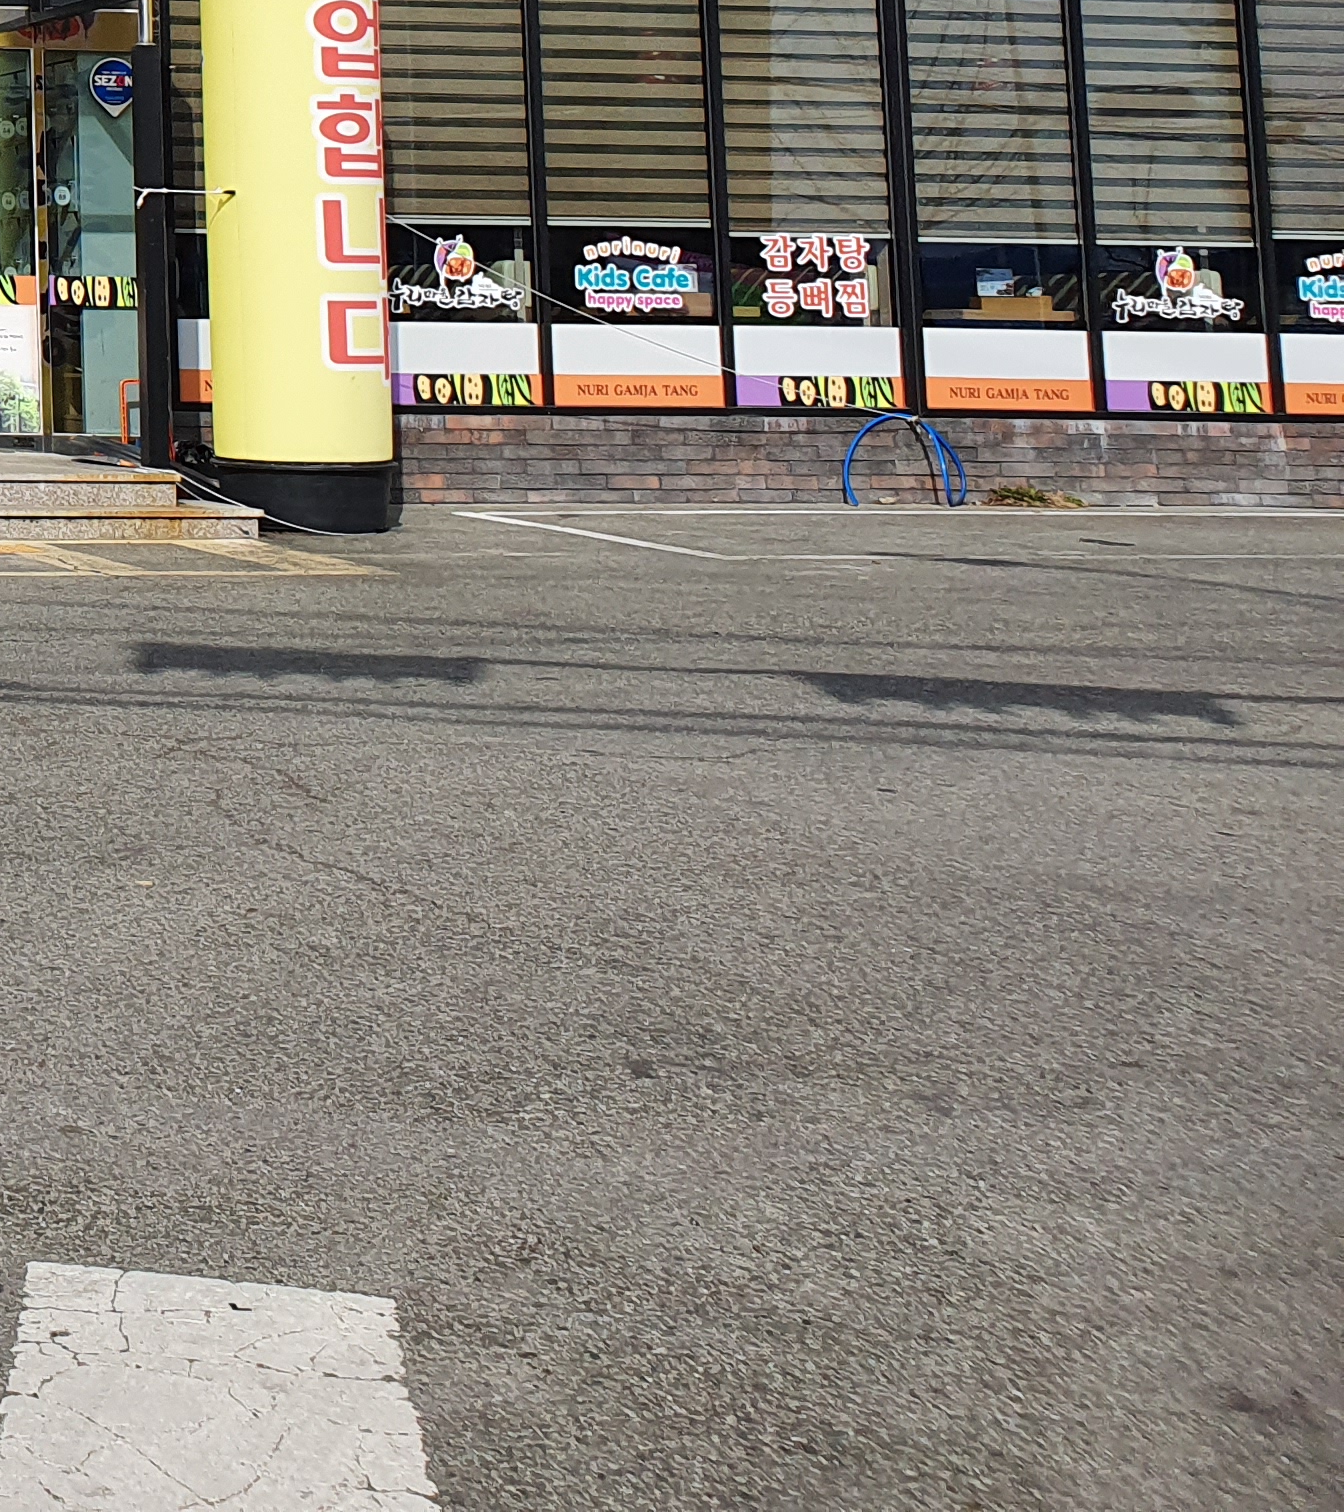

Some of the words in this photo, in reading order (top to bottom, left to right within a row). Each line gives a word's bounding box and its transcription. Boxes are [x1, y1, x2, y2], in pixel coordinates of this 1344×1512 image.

[584, 238, 680, 263] nurinuri
[761, 234, 869, 272] 감자탕
[576, 265, 629, 289] Kids
[634, 266, 691, 290] Cafe
[586, 291, 633, 311] happy
[637, 294, 682, 312] space
[763, 279, 869, 317] 등뼈찜
[576, 383, 610, 397] NURI
[614, 384, 659, 398] GAMJA
[662, 384, 699, 397] TANG
[948, 386, 981, 400] NURI
[985, 387, 1030, 402] GAMJA
[1034, 388, 1070, 401] TANG
[1305, 392, 1337, 405] NURI
